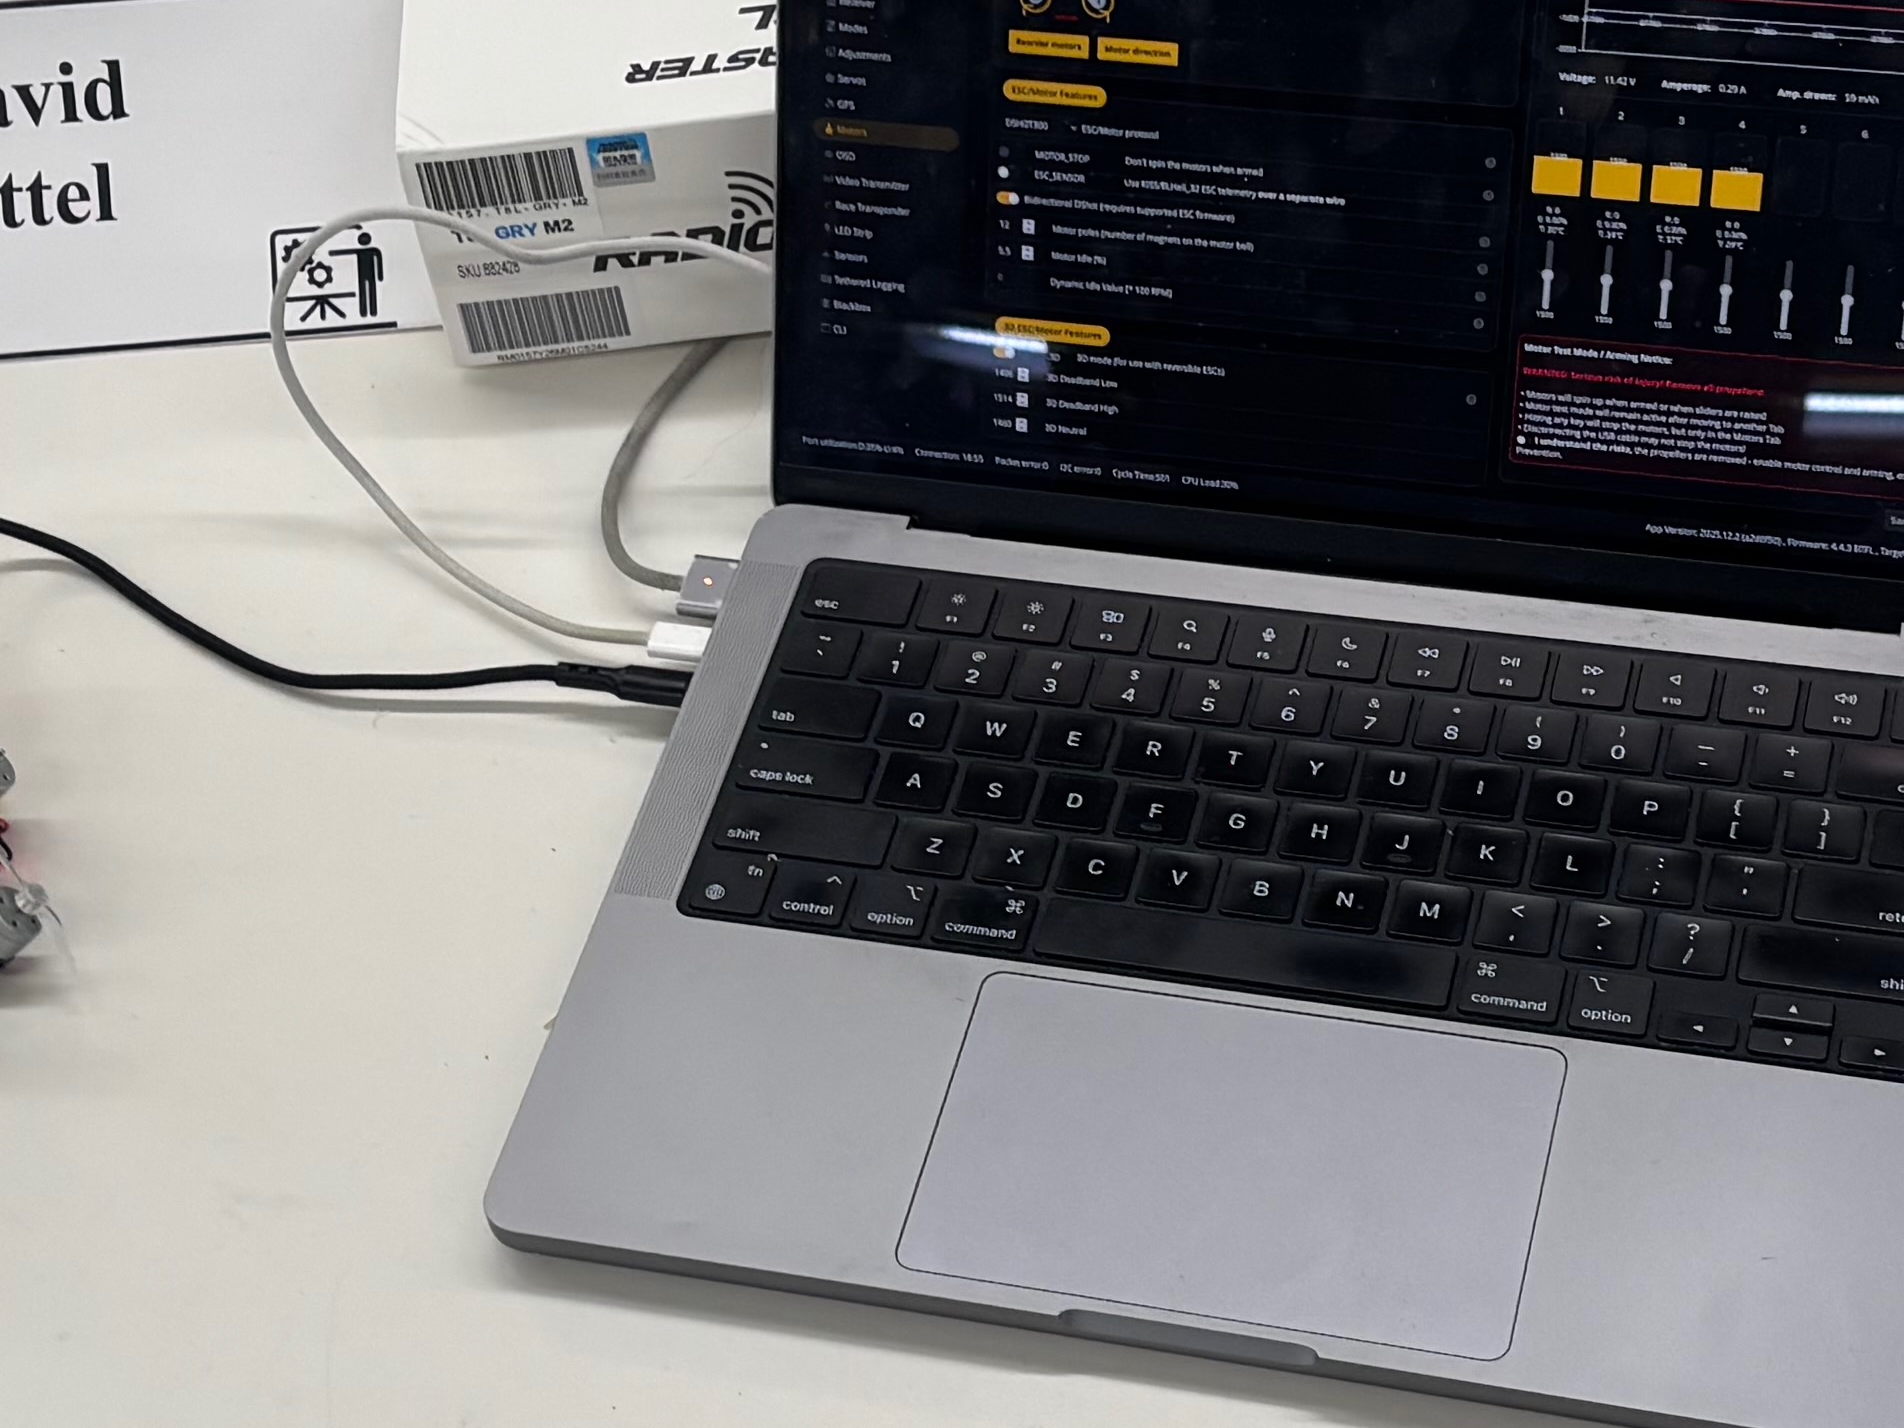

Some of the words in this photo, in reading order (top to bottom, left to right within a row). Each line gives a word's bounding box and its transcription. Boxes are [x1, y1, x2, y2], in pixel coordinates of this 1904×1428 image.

[495, 223, 537, 239] GRY
[544, 218, 575, 234] M2
[815, 600, 838, 609] esc
[892, 661, 899, 673] 1
[965, 669, 979, 683] 2
[1043, 679, 1056, 692] 3
[1122, 688, 1135, 702] 4
[1201, 698, 1215, 711] 5
[772, 711, 794, 721] tab
[909, 713, 924, 728] Q
[1281, 707, 1295, 721] 6
[986, 721, 1007, 736] W
[1364, 716, 1376, 729] 7
[1067, 731, 1082, 746] E
[1444, 726, 1458, 739] 8
[1146, 741, 1161, 756] R
[1528, 735, 1541, 749] 9
[1229, 751, 1242, 765] T
[1611, 745, 1625, 759] 0
[1310, 761, 1324, 775] Y
[750, 770, 782, 780] caps
[785, 772, 812, 784] lock
[907, 774, 920, 788] A
[1389, 770, 1405, 785] U
[987, 783, 1003, 797] S
[1477, 781, 1484, 794] I
[1067, 793, 1082, 808] D
[1557, 791, 1573, 806] O
[1149, 804, 1164, 817] F
[1643, 801, 1658, 815] P
[1229, 814, 1245, 828] G
[727, 829, 760, 841] shift
[1311, 824, 1328, 839] H
[926, 838, 943, 853] Z
[1395, 835, 1409, 849] J
[1007, 848, 1024, 864] X
[1480, 845, 1495, 860] K
[1089, 859, 1104, 874] C
[1566, 855, 1578, 871] L
[1172, 870, 1188, 885] V
[1254, 881, 1269, 896] B
[1336, 891, 1354, 907] N
[783, 901, 833, 915] control
[1420, 902, 1440, 918] M
[868, 913, 913, 925] option
[945, 923, 1016, 939] command
[1471, 994, 1546, 1011] command
[1582, 1009, 1631, 1022] option
